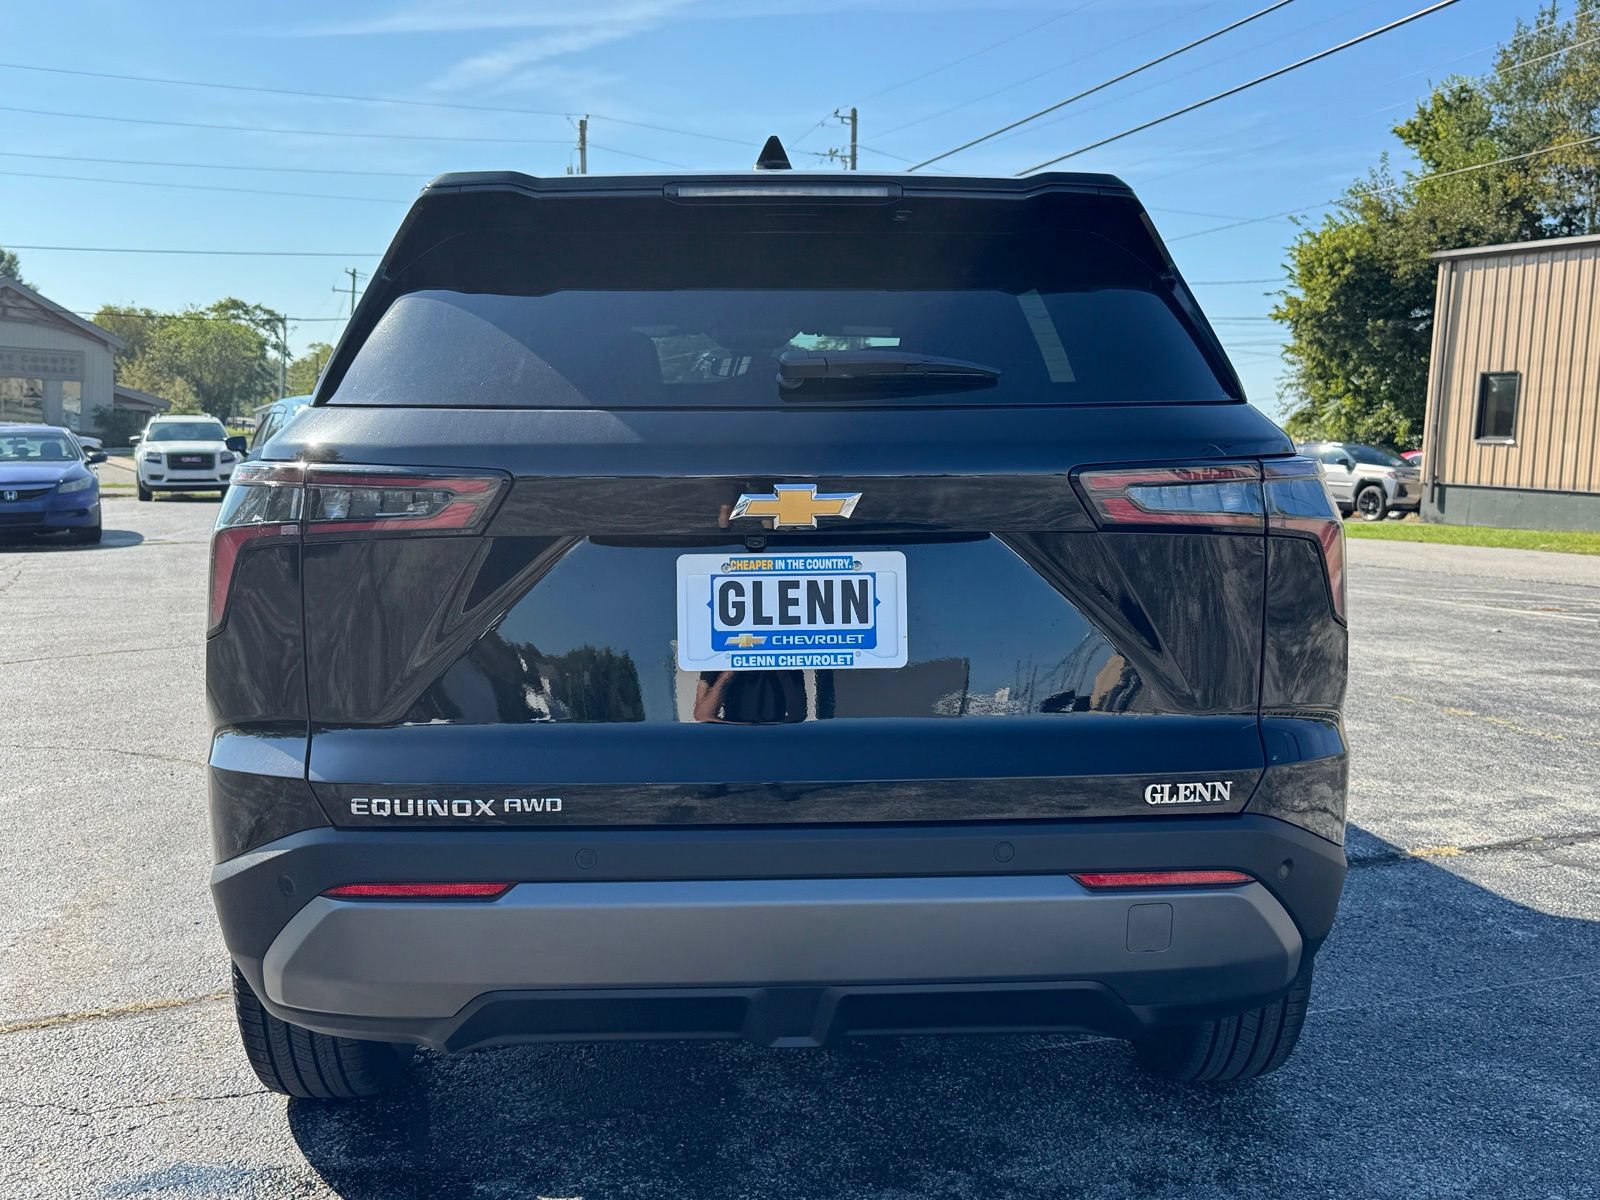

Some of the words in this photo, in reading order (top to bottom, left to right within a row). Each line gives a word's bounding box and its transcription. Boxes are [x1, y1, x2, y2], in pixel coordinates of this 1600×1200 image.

[729, 559, 773, 571] CHEAPER
[775, 559, 785, 570] IN
[787, 559, 804, 570] THE
[806, 558, 852, 570] COUNTRY.
[718, 579, 869, 626] GLENN
[771, 634, 865, 645] CHEVROLET
[733, 655, 776, 667] GLENN
[778, 654, 853, 666] CHEVROLET
[1144, 781, 1233, 805] GLENN
[350, 798, 497, 816] EQUINOX
[503, 798, 563, 812] AWD
